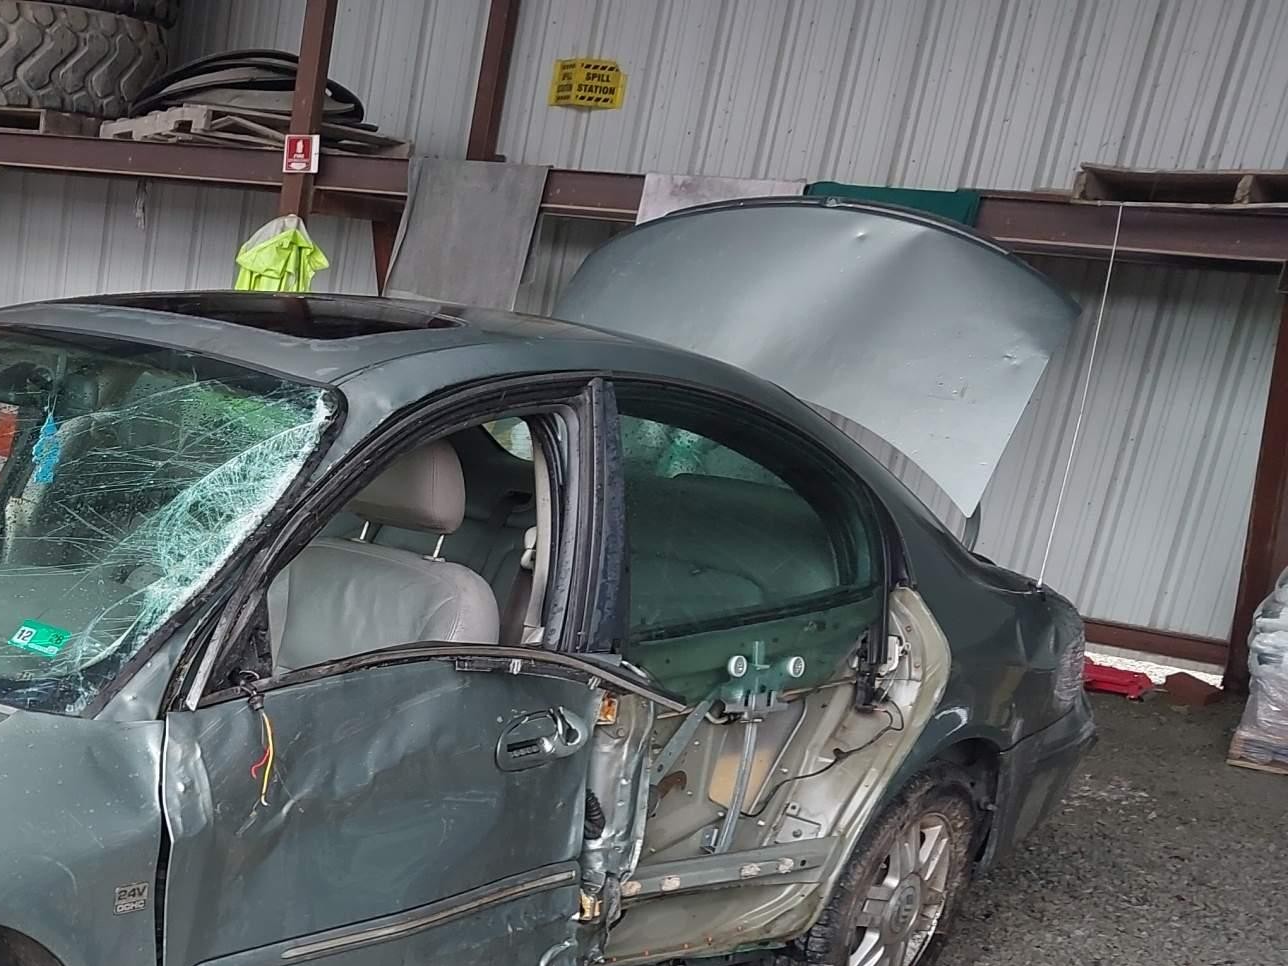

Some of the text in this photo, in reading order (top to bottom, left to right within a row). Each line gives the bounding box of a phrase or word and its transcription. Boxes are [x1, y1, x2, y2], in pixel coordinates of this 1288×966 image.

[585, 72, 611, 82] SPILL
[577, 84, 616, 95] STATION
[118, 885, 146, 900] 24V
